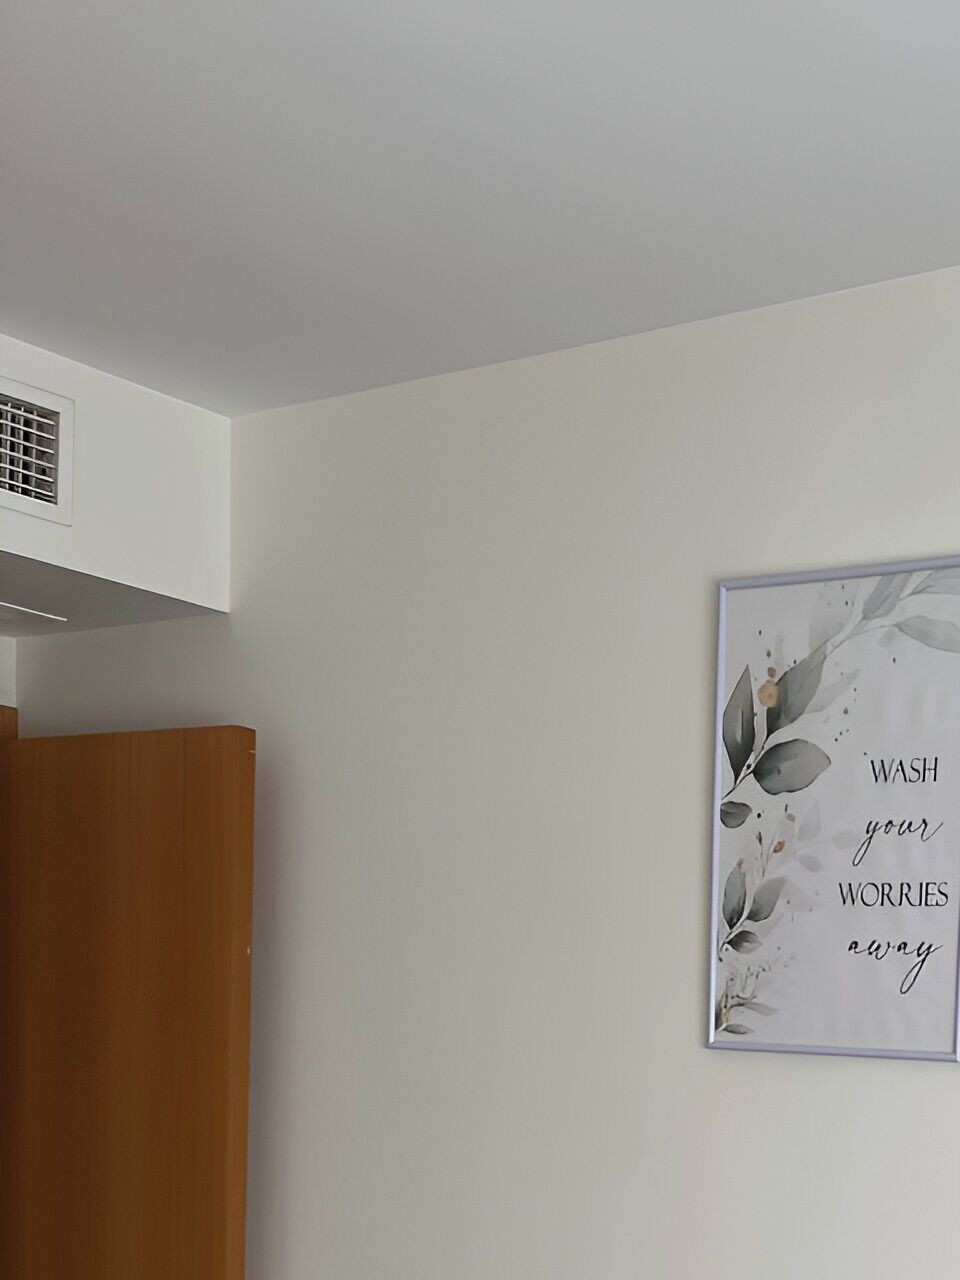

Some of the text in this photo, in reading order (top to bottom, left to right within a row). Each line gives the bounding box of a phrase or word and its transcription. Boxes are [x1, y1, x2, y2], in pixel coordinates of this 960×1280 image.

[870, 757, 938, 783] WASH
[852, 818, 943, 866] your
[838, 882, 949, 907] WORRIES
[848, 939, 943, 994] away
